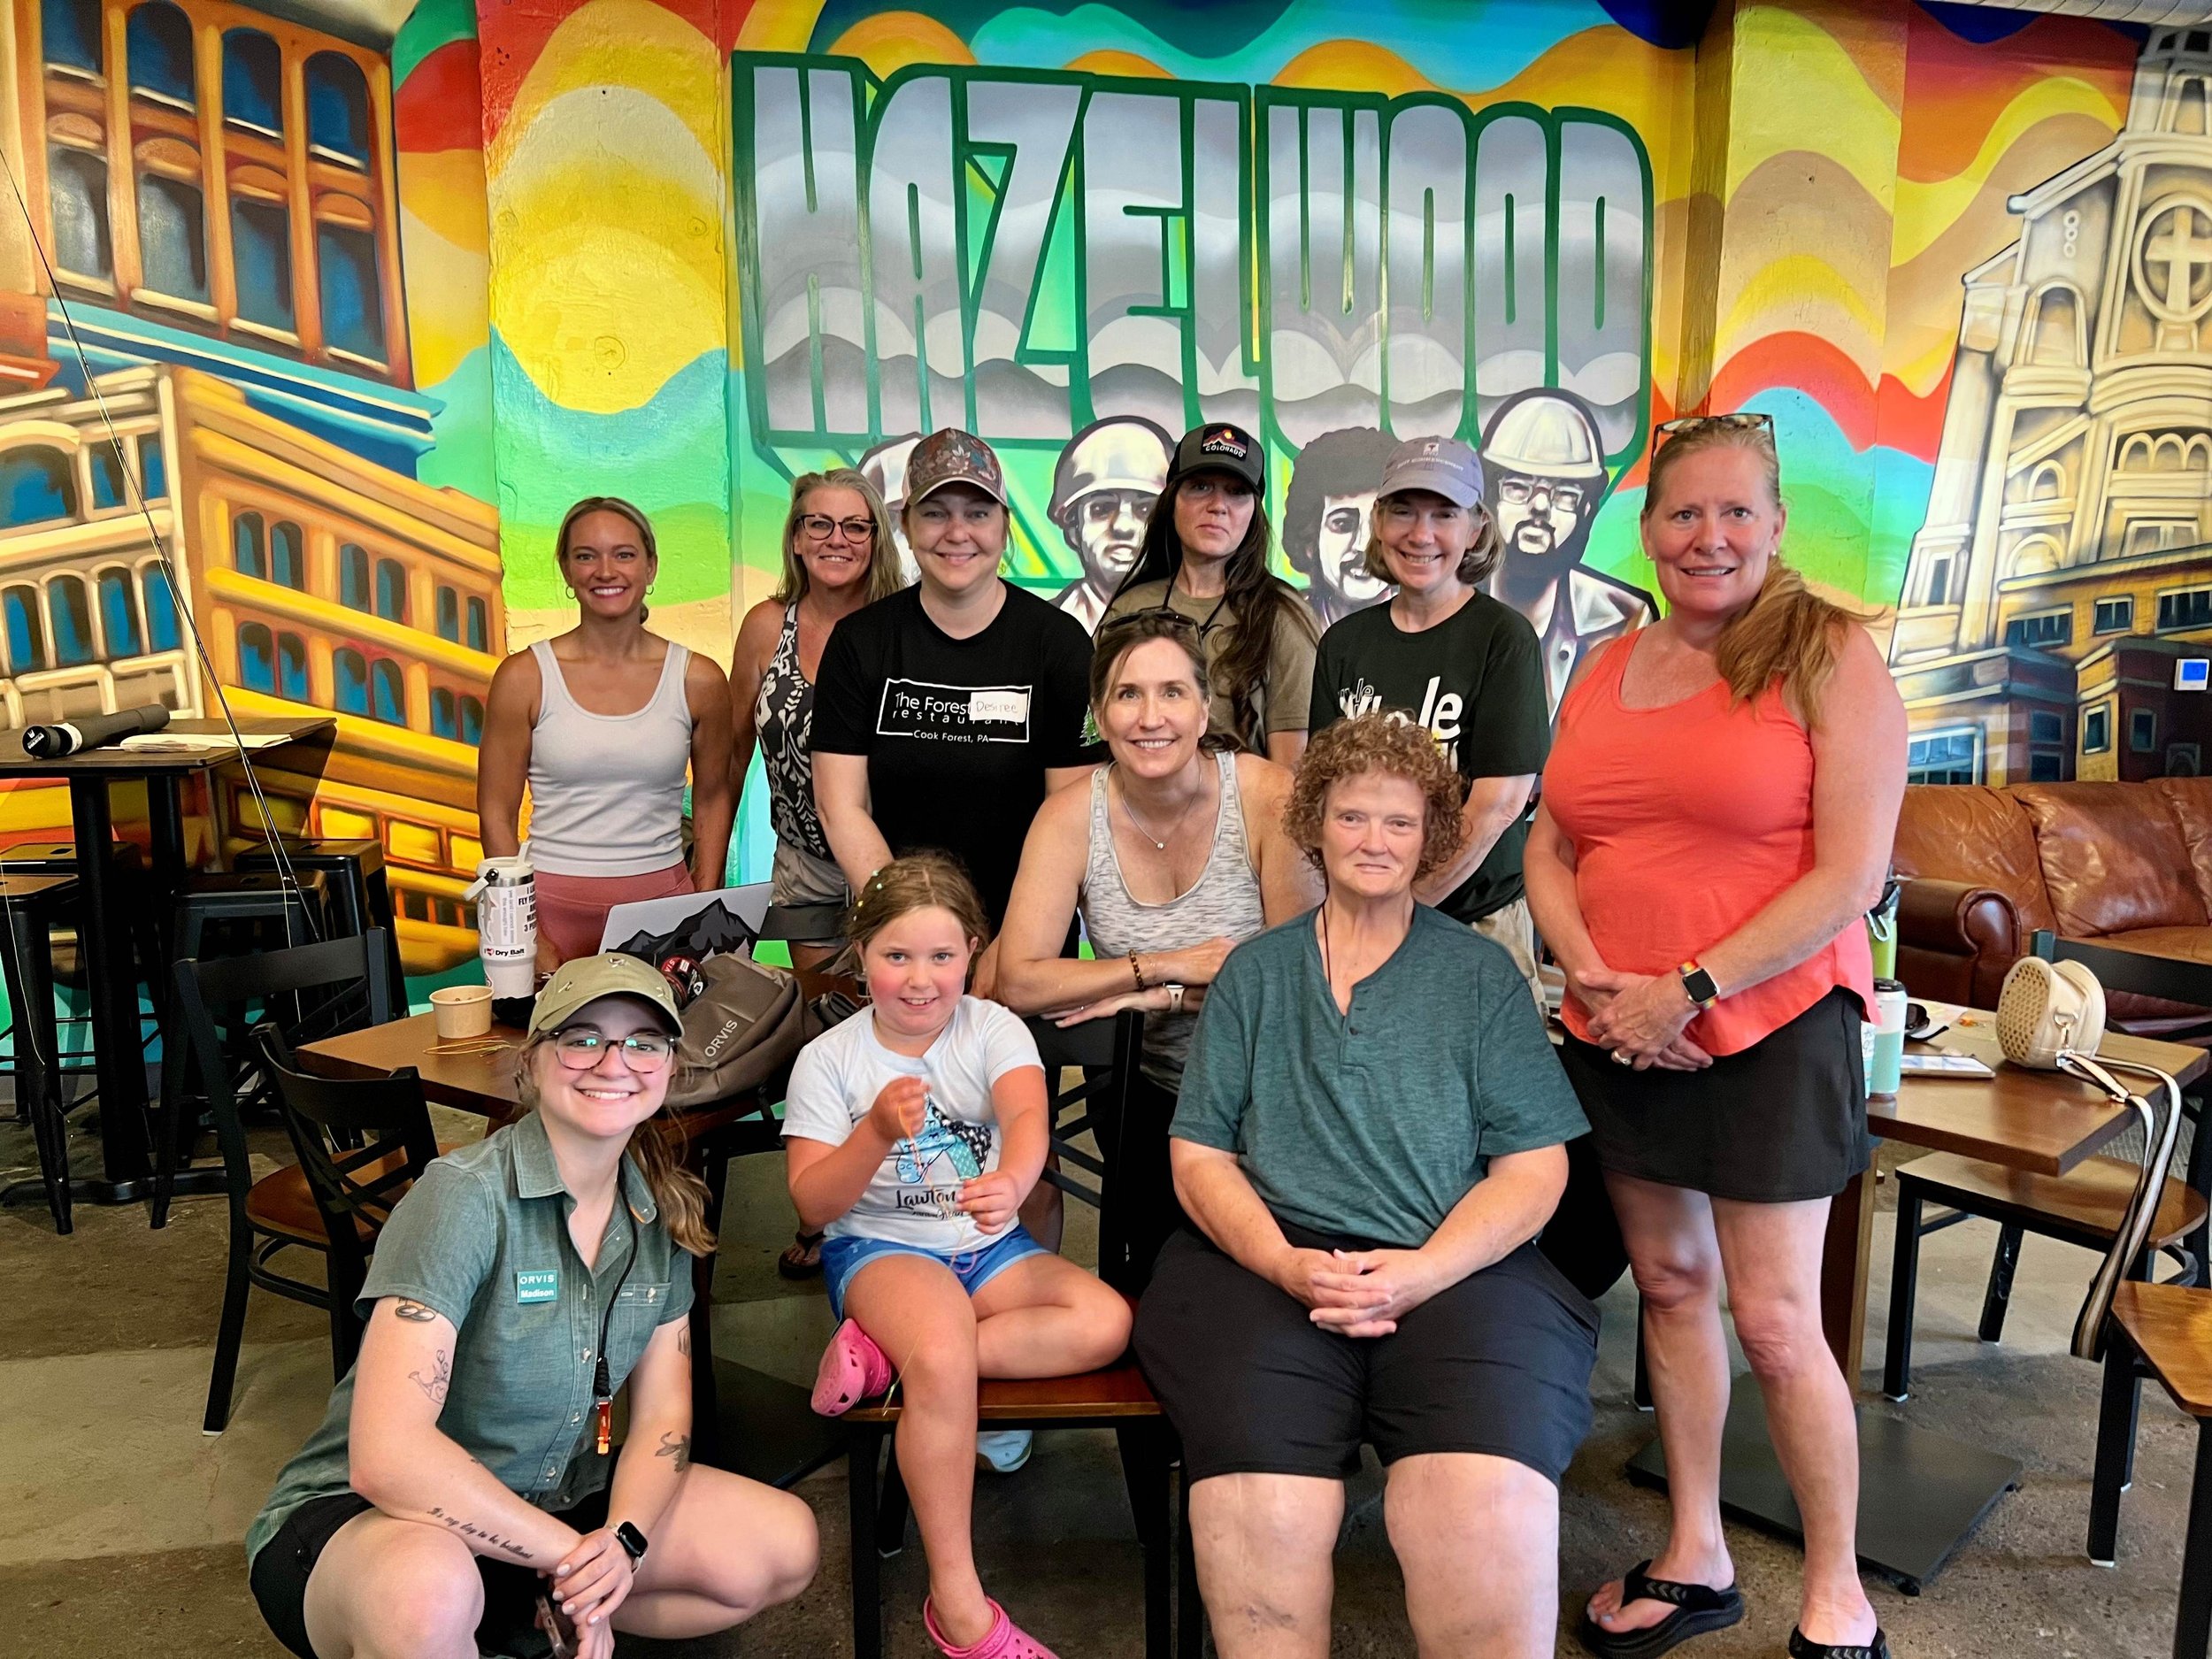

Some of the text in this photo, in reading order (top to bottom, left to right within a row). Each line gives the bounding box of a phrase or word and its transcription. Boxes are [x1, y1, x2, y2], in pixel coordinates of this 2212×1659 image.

[733, 51, 1651, 462] HAZELWOOD
[1205, 445, 1244, 457] COLORADO
[895, 692, 920, 709] The
[893, 710, 1019, 726] restau
[913, 730, 990, 743] Cook Forest, PA
[518, 896, 527, 905] FLY
[704, 1019, 738, 1057] ORVIS
[895, 1187, 956, 1210] Lawton
[519, 1274, 555, 1285] ORVIS
[520, 1288, 555, 1298] Madison
